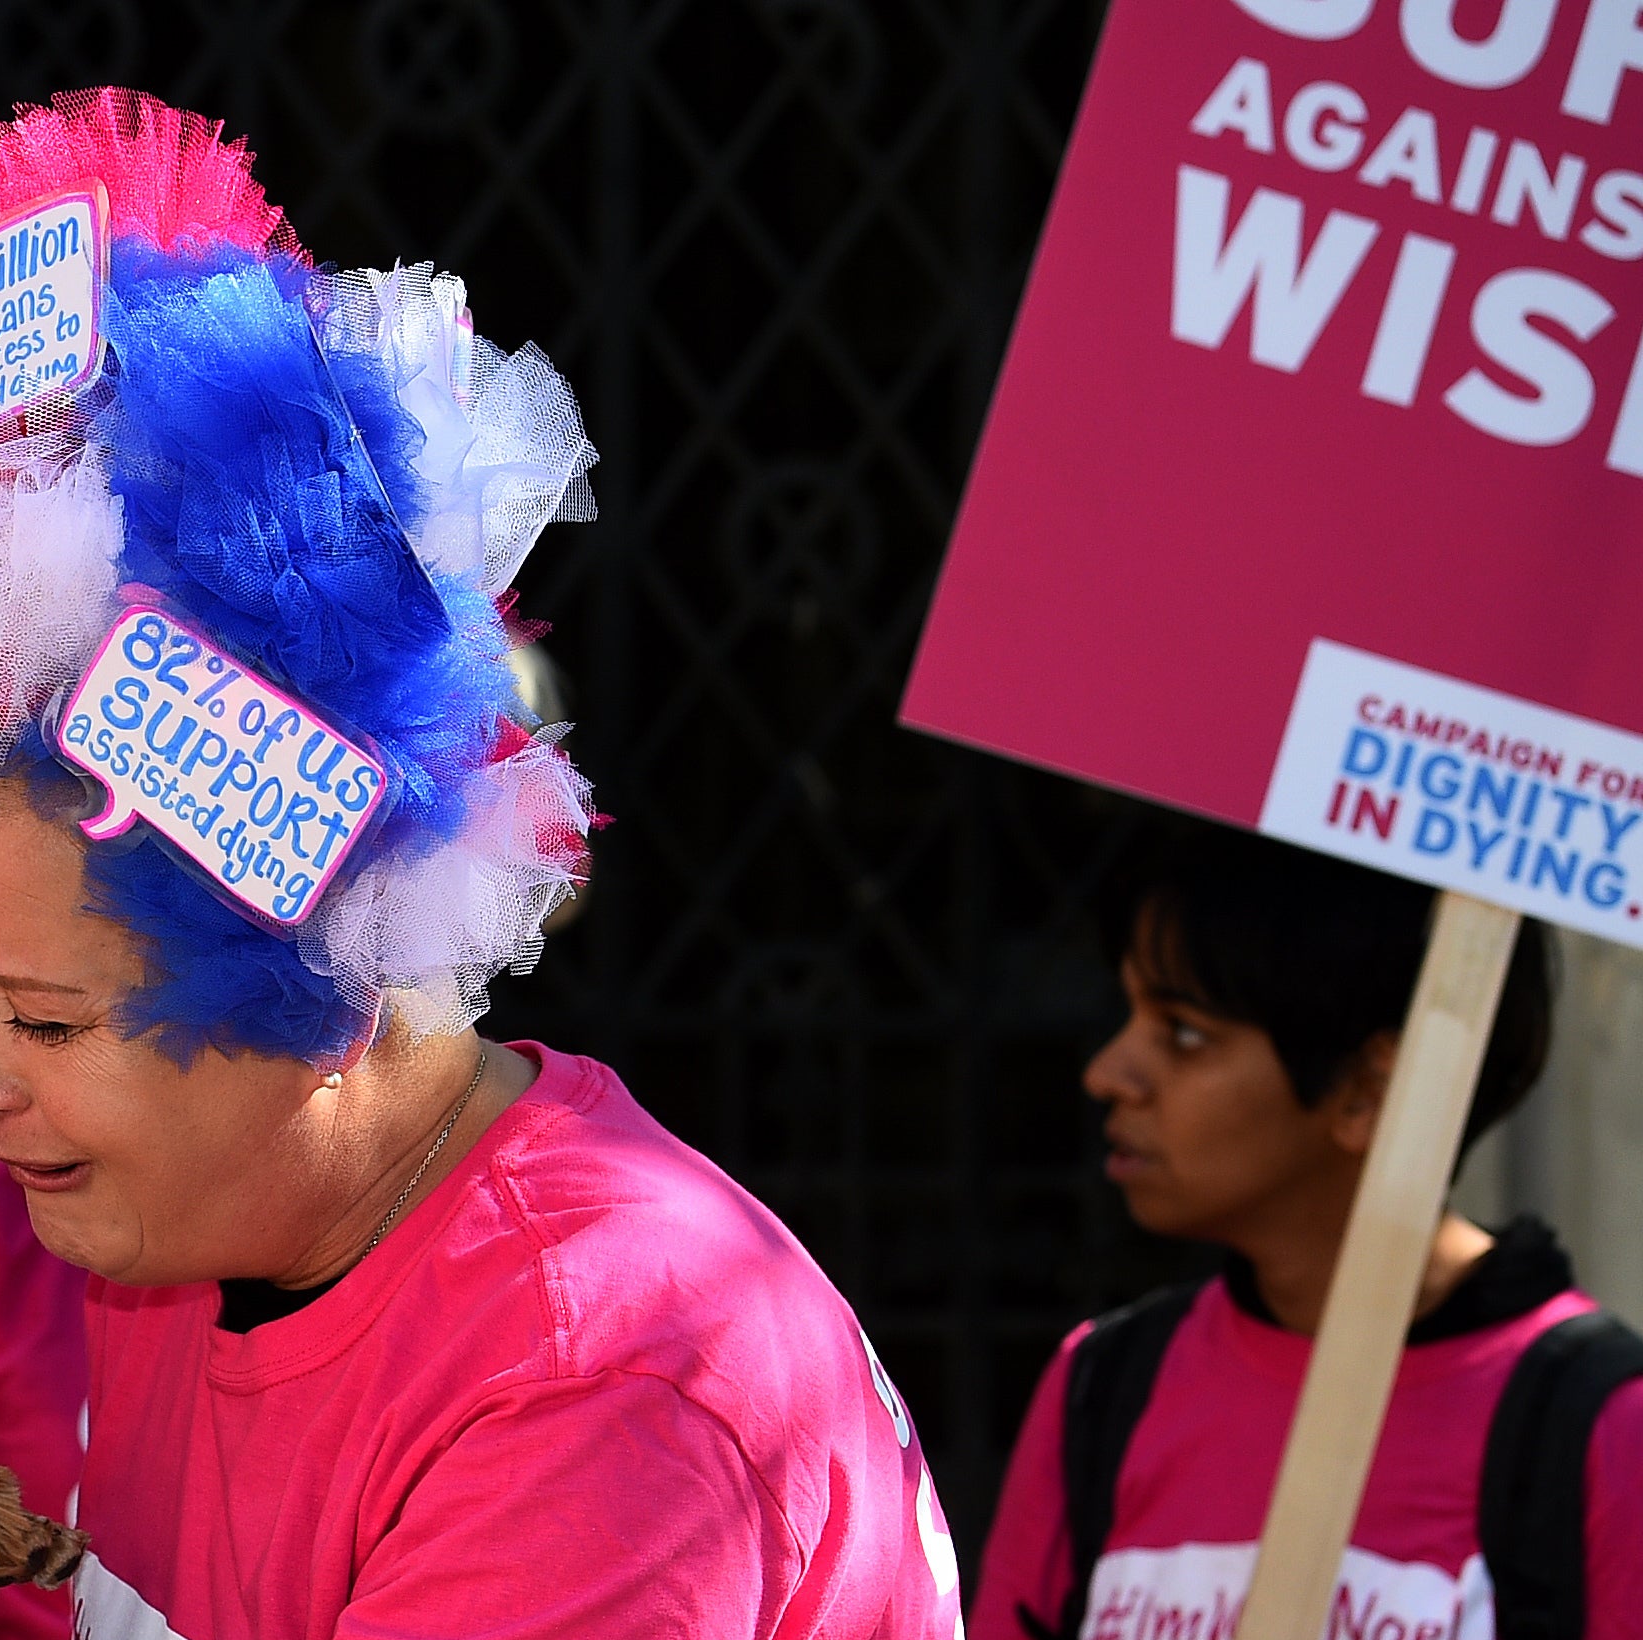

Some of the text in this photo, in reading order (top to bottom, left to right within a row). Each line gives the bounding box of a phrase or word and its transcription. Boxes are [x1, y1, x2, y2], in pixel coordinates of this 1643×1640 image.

[56, 311, 80, 342] to
[122, 615, 242, 718] 82%
[239, 699, 301, 762] of
[1357, 695, 1565, 777] CAMPAIGN
[66, 714, 315, 920] assisted dying
[1325, 781, 1641, 918] IN DYING.
[1342, 725, 1640, 853] DIGNITY
